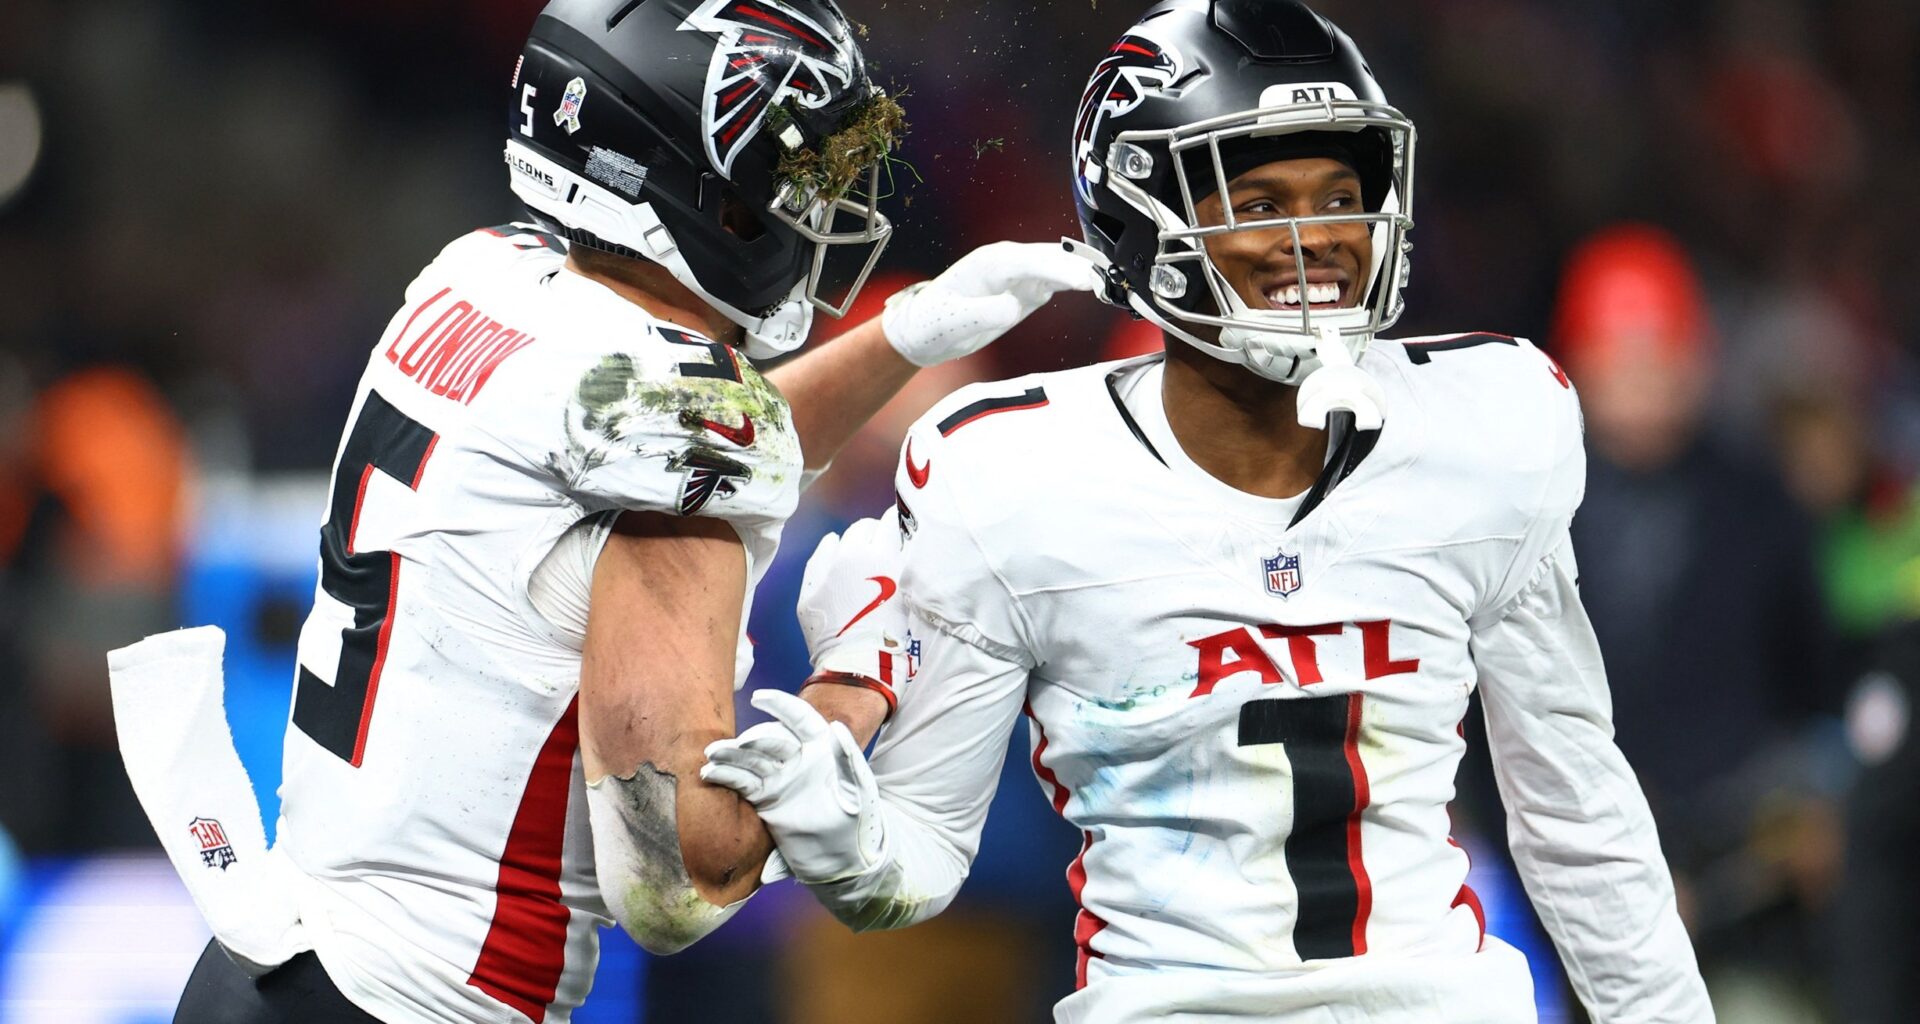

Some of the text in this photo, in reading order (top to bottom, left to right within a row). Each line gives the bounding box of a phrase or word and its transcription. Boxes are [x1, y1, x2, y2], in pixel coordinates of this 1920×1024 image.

[521, 82, 537, 138] 5
[1291, 87, 1342, 104] ATL
[504, 151, 554, 187] ALCONS
[385, 286, 536, 407] LONDON
[936, 386, 1050, 438] 1
[291, 388, 441, 769] 5
[1270, 570, 1299, 592] NFL
[1186, 618, 1420, 699] ATL
[190, 822, 227, 849] NFL
[1237, 690, 1373, 963] 1
